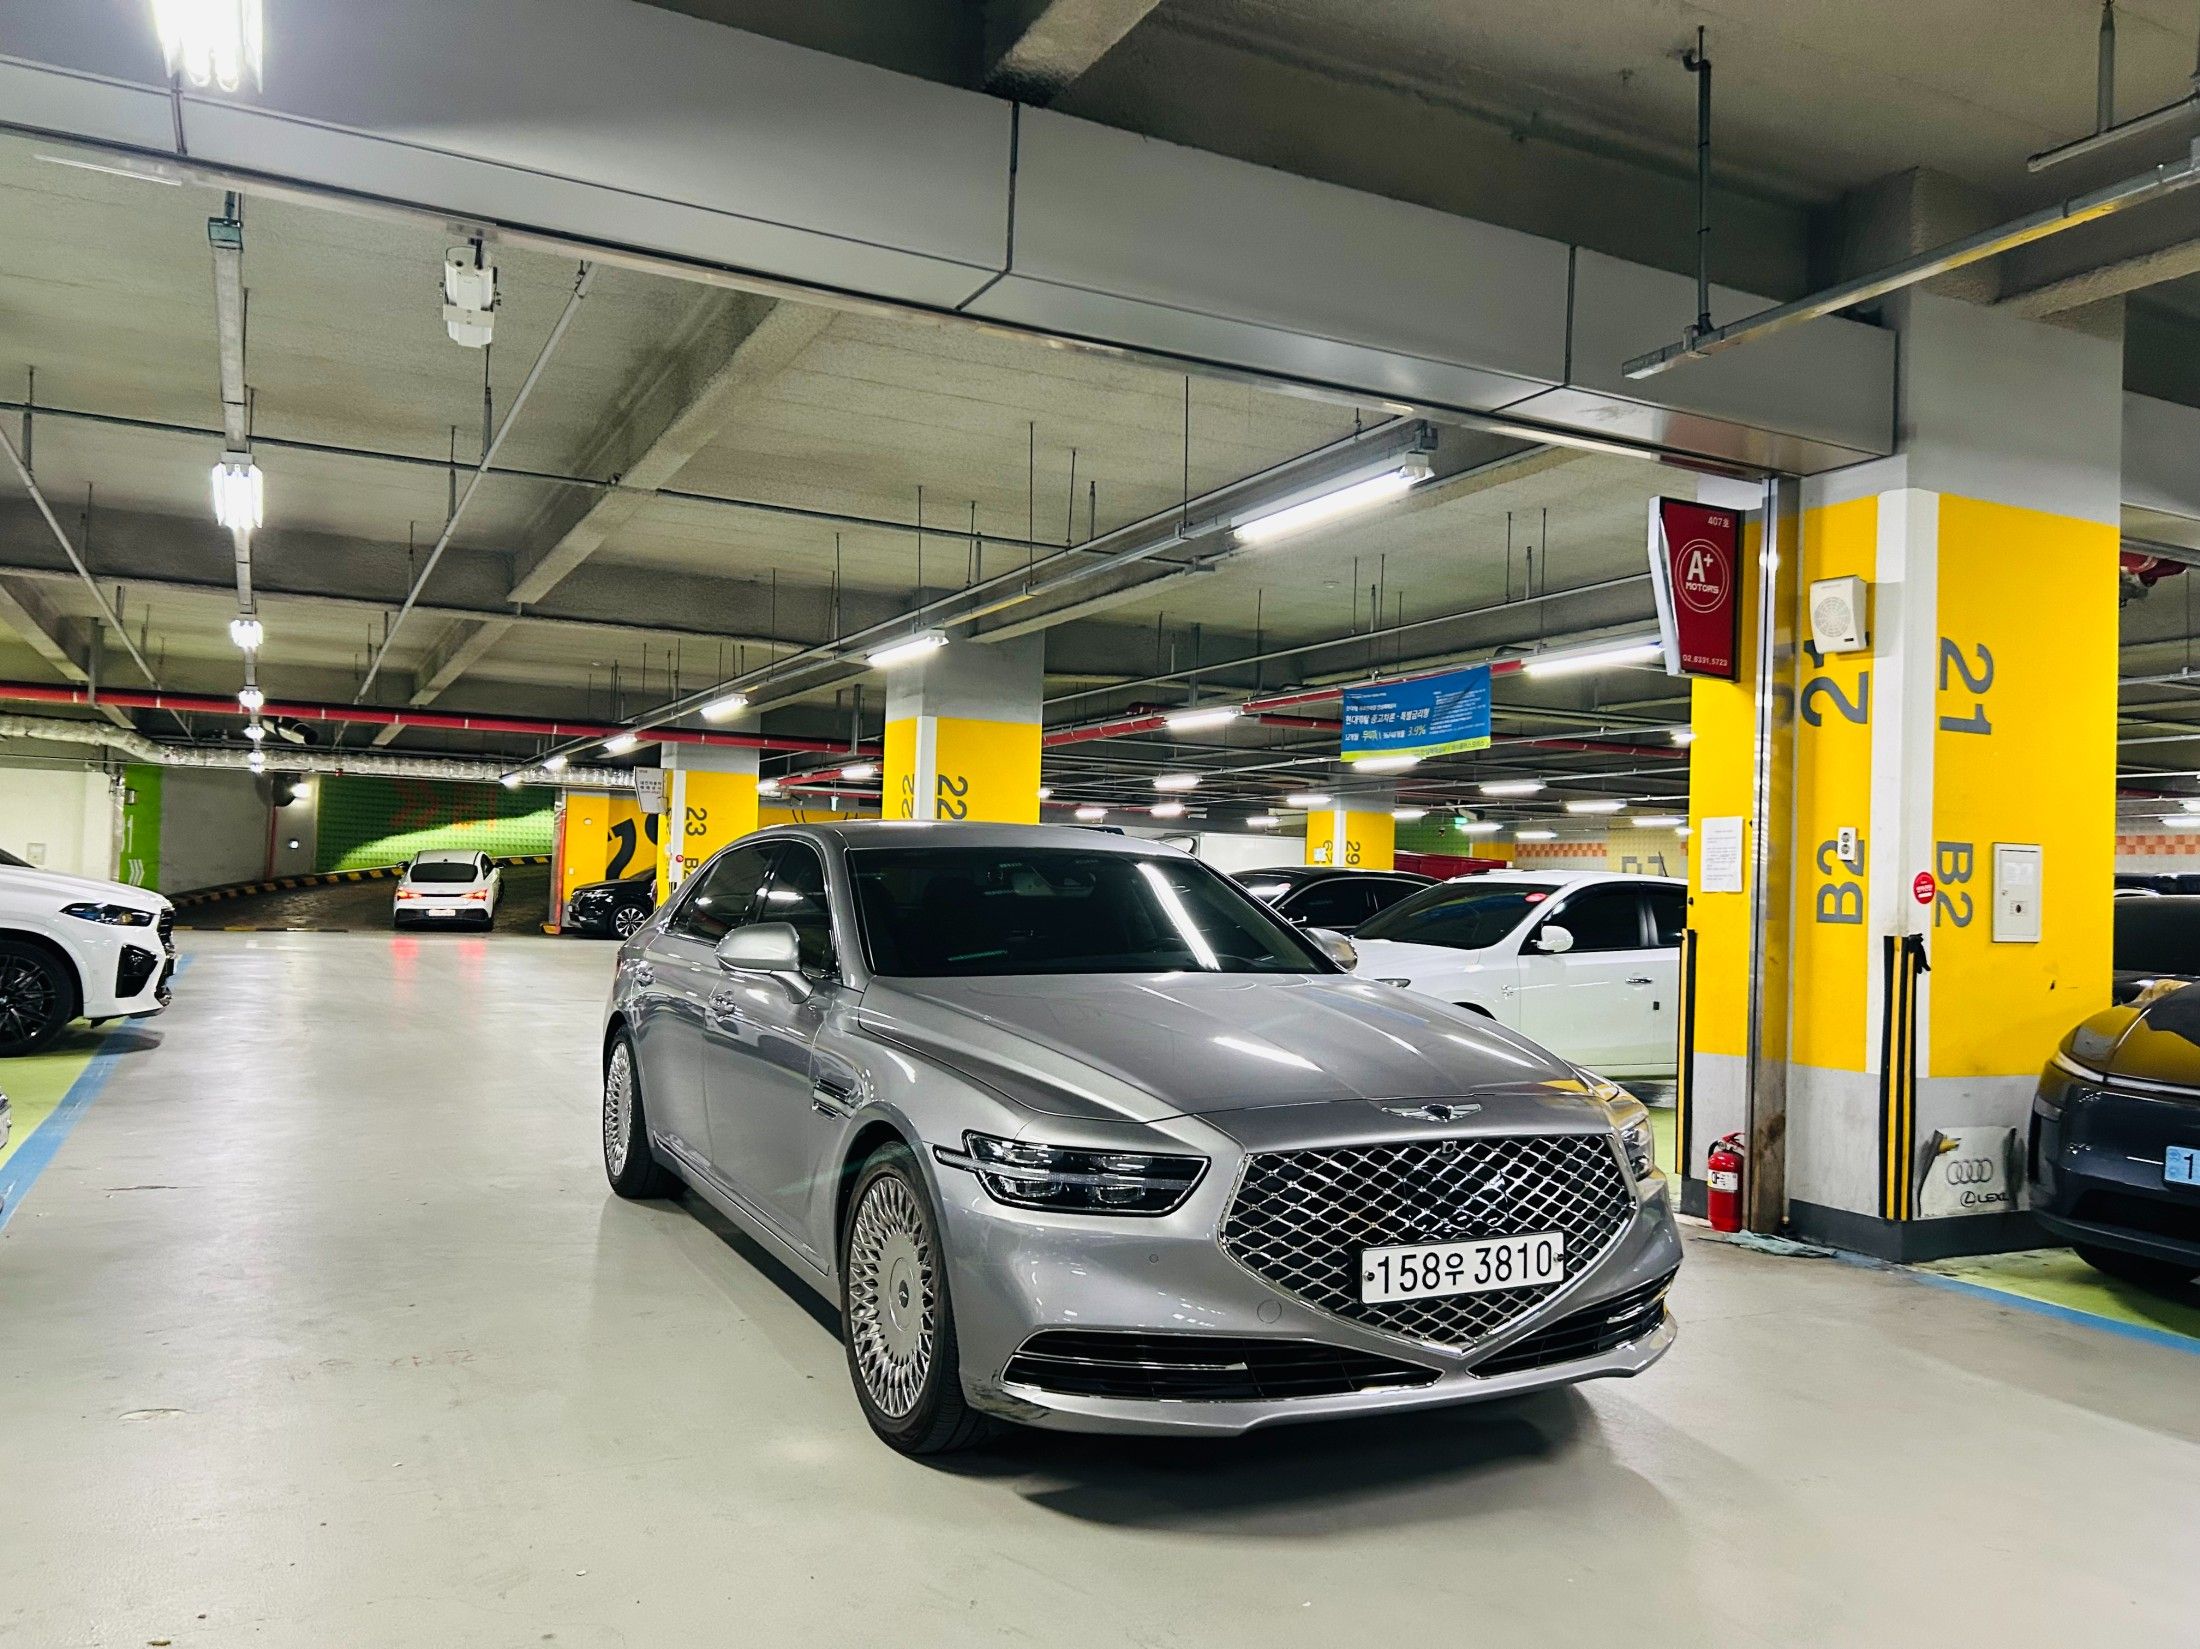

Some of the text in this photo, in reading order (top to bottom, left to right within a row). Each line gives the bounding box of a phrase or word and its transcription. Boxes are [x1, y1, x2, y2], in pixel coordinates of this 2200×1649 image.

[1687, 550, 1714, 582] A+
[1685, 582, 1720, 595] MOTORS
[1801, 638, 1869, 729] 2
[1938, 635, 1994, 736] 21
[901, 774, 915, 818] 22
[937, 774, 969, 819] 22
[685, 807, 708, 836] 23
[1345, 840, 1361, 865] 29
[1935, 841, 1974, 928] B2
[1377, 1240, 1553, 1295] 158우 3810
